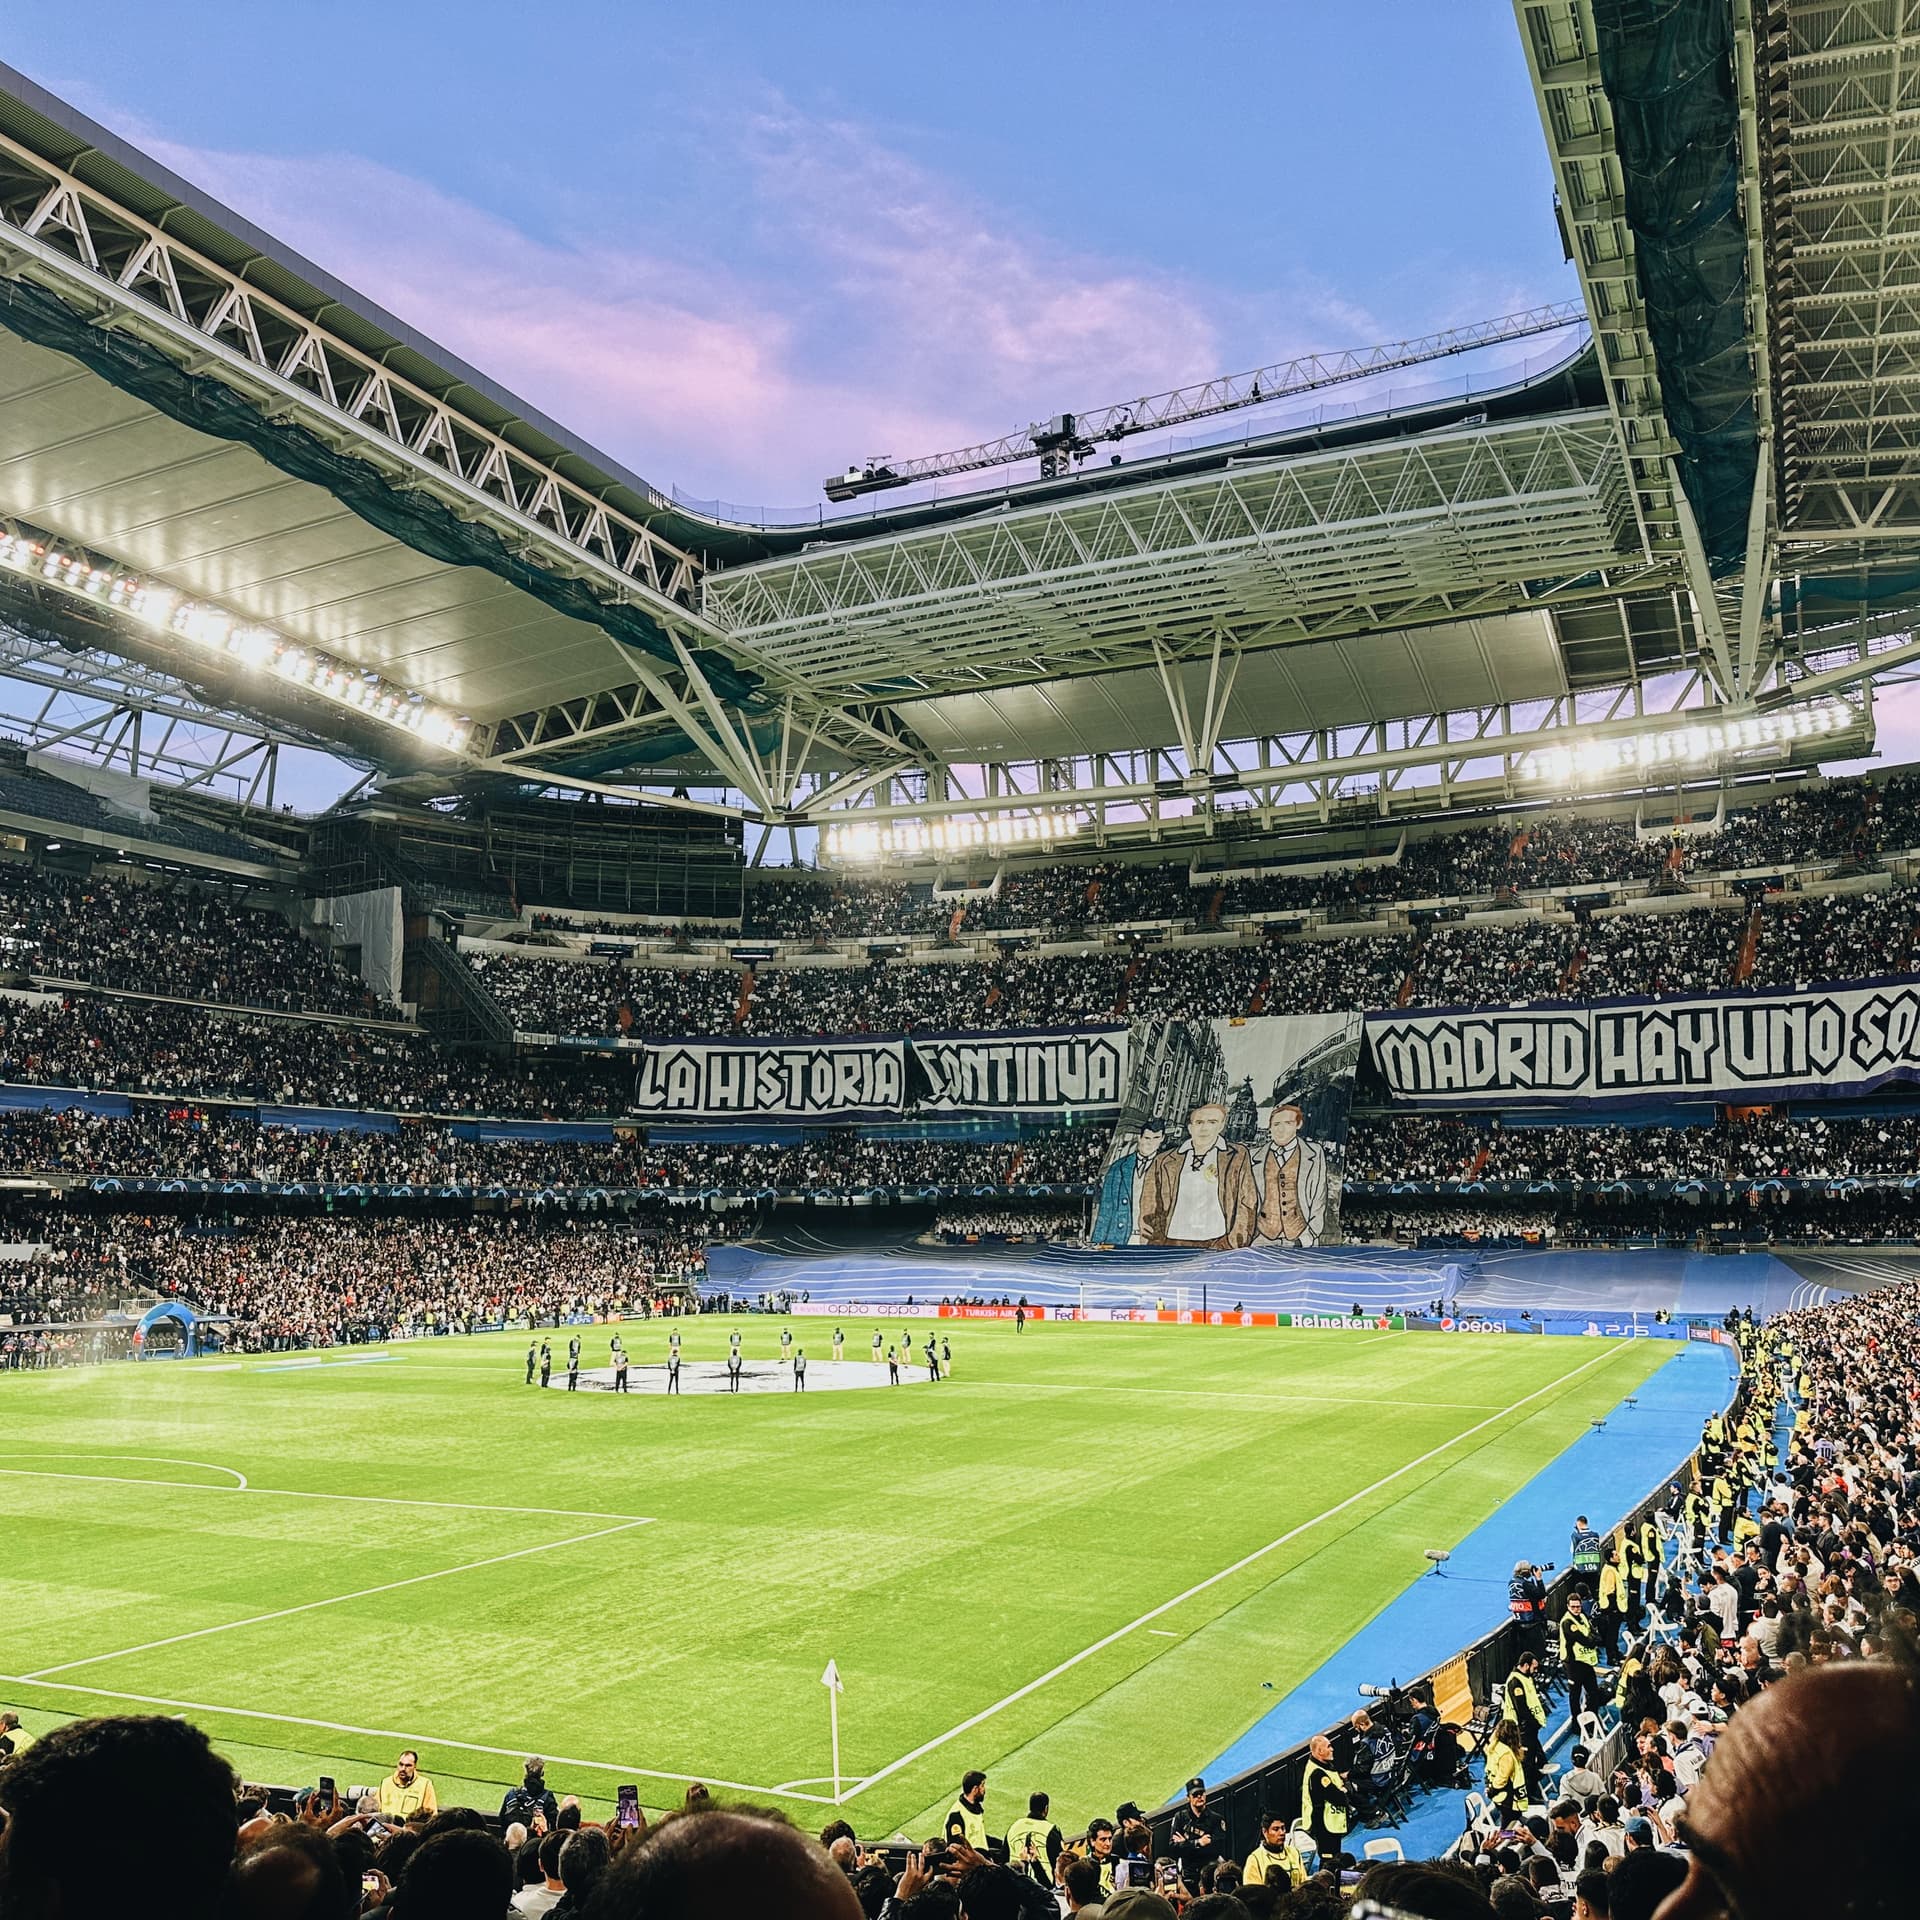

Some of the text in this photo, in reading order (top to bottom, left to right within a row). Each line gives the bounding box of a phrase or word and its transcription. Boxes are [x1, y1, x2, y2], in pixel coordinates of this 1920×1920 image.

[575, 1036, 598, 1046] Madrid
[1374, 1018, 1590, 1091] MADRID
[1595, 1007, 1720, 1089] HAY
[1723, 998, 1846, 1081] UNO
[637, 1049, 902, 1109] LA HISTORIA
[828, 1304, 868, 1317] oppo
[878, 1305, 919, 1318] oppo
[965, 1309, 998, 1318] TURKISH
[1111, 1309, 1146, 1321] FedEx
[1291, 1314, 1374, 1329] Heineken
[1459, 1319, 1506, 1333] pepsi
[1605, 1324, 1650, 1336] PS5
